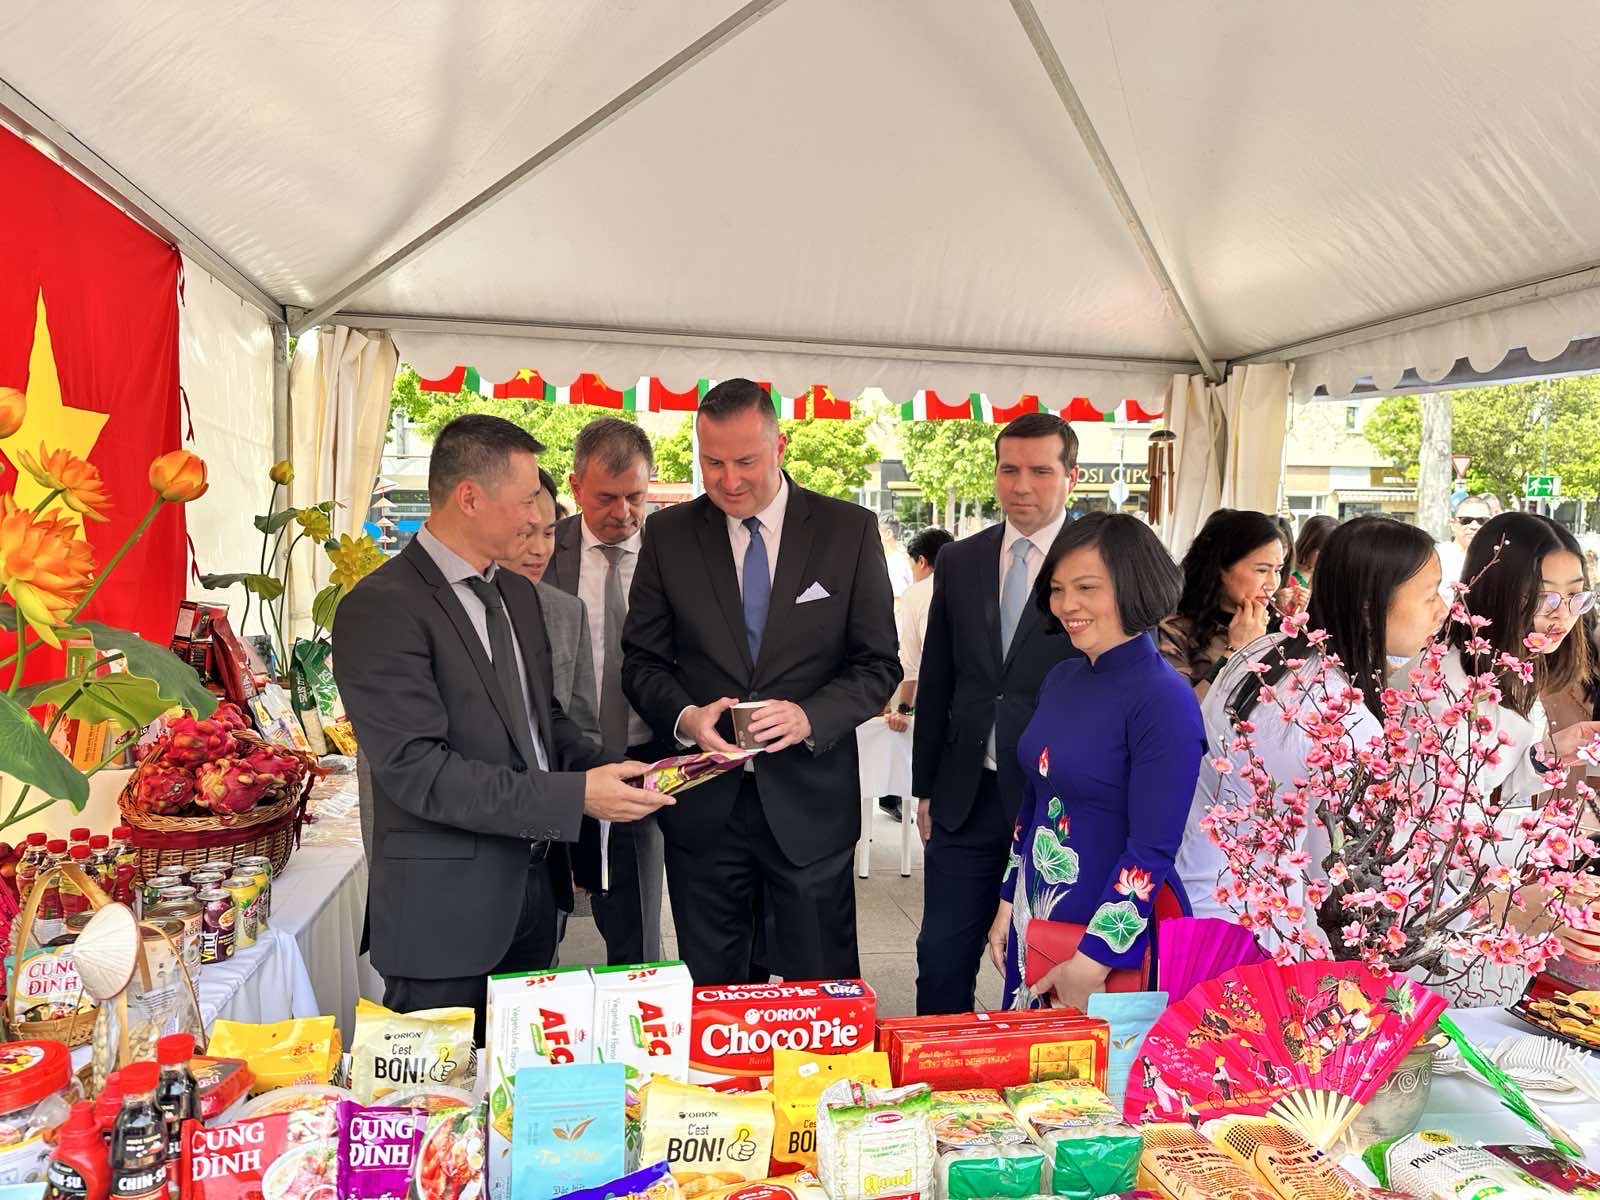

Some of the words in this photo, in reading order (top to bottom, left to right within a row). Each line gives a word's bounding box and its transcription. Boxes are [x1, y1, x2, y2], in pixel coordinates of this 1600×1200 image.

[526, 974, 557, 987] AFC
[627, 968, 658, 981] AFC
[763, 1007, 817, 1022] ORION
[393, 1031, 422, 1040] ORION
[538, 1007, 575, 1065] AFC
[637, 1000, 672, 1057] AFC
[375, 1056, 426, 1084] BON!
[350, 1116, 413, 1141] CUNG
[687, 1123, 710, 1136] C'est
[803, 1119, 817, 1129] C'es
[191, 1122, 265, 1154] CUNG
[666, 1137, 725, 1163] BON!
[191, 1148, 263, 1182] ĐÌNH
[349, 1139, 411, 1167] ĐÌNH
